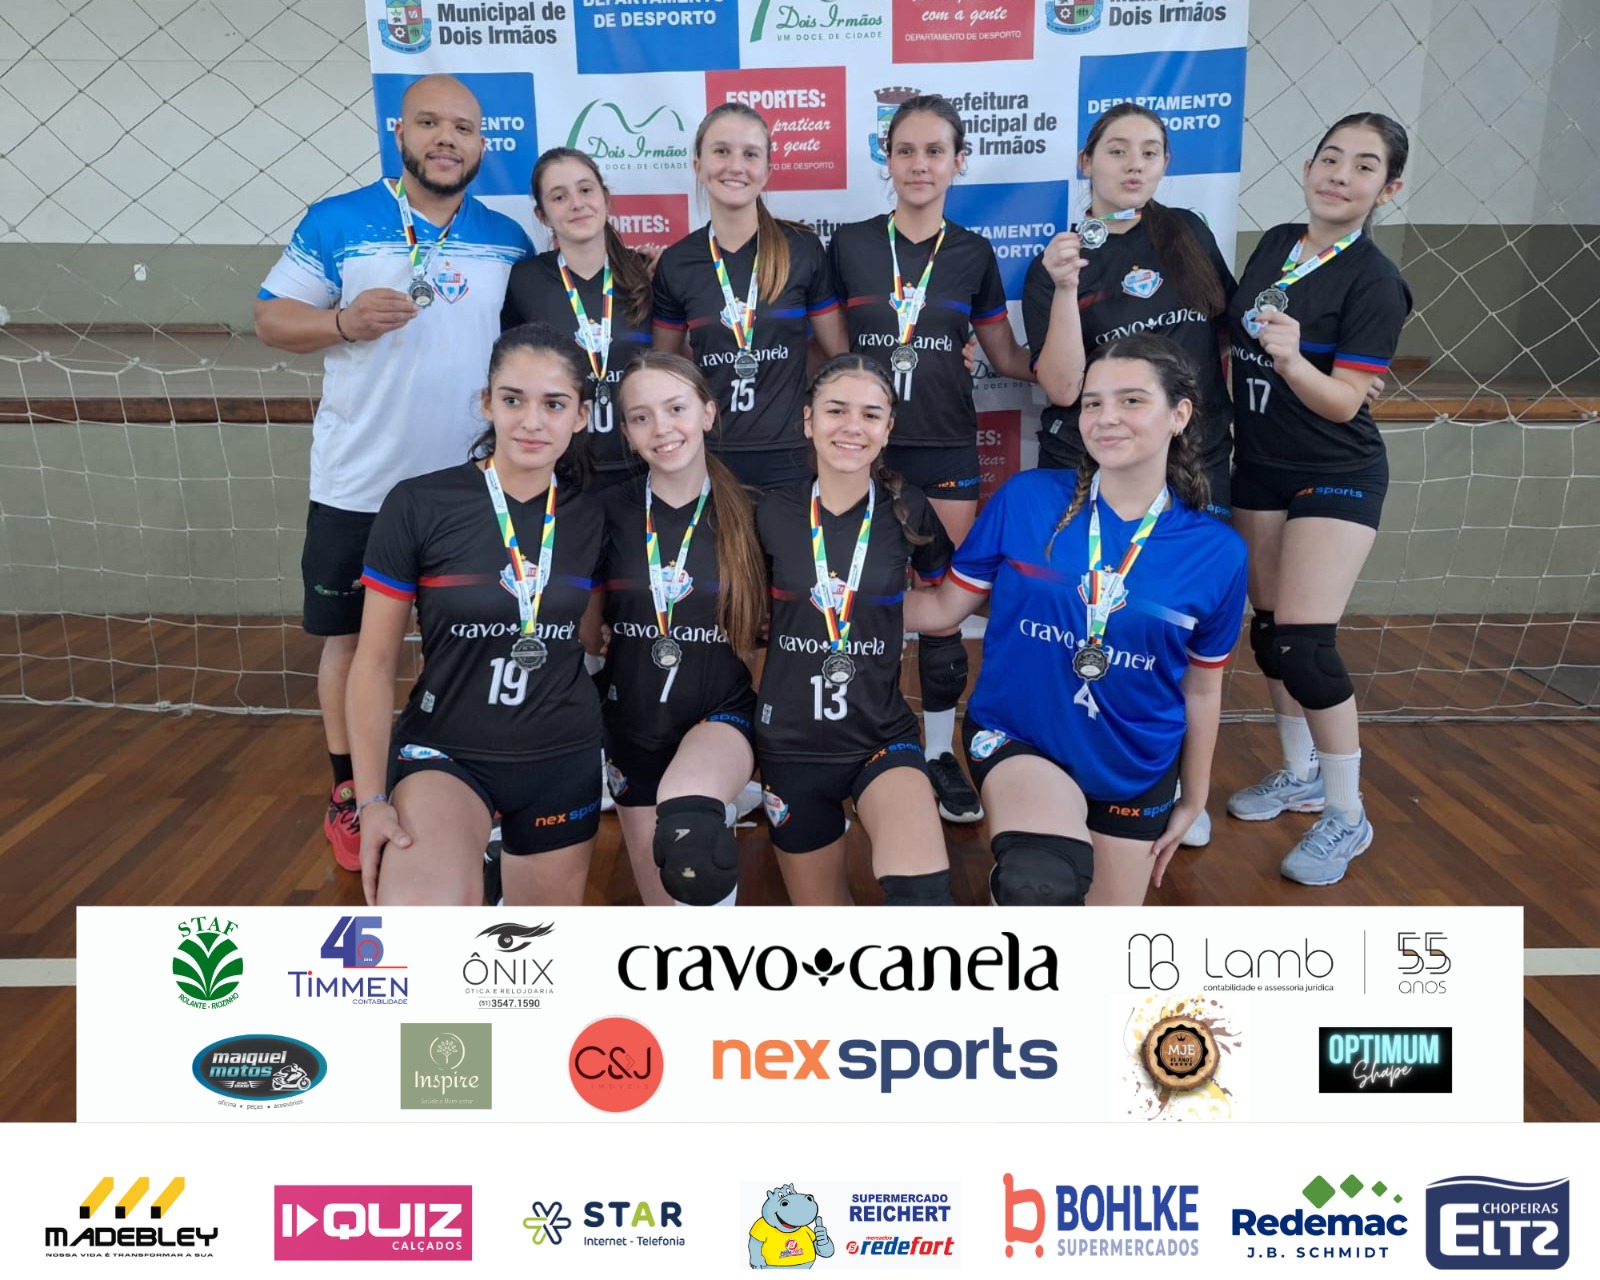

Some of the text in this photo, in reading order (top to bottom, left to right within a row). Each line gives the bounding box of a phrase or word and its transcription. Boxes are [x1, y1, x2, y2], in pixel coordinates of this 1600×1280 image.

[437, 2, 566, 25] Municipal de
[594, 10, 717, 28] DE DESPORTO
[776, 4, 883, 29] Dois Irmãos
[921, 6, 1008, 26] com a gente
[1109, 2, 1227, 26] Dois Irmãos
[439, 26, 482, 45] Dois
[488, 25, 557, 44] Irmãos
[796, 33, 823, 41] DOCE
[845, 31, 883, 39] CIDADE
[905, 30, 1021, 42] DEPARTAMENTO DE DESPORTO
[771, 117, 831, 136] praticar
[963, 112, 1057, 137] nicipal de
[588, 136, 688, 159] Dois Irmãos
[783, 138, 820, 157] gente
[979, 136, 1046, 155] Irmãos
[605, 163, 632, 171] DOCE
[653, 162, 689, 170] CIDADE
[782, 163, 793, 171] DE
[794, 161, 835, 170] DESPORTO
[730, 378, 756, 413] 15
[1246, 377, 1272, 415] 17
[1316, 486, 1364, 499] sports
[1019, 618, 1075, 650] cravo
[487, 657, 530, 707] 19
[810, 674, 849, 722] 13
[1073, 681, 1100, 721] 4
[535, 812, 567, 828] nex
[1108, 804, 1141, 818] nex
